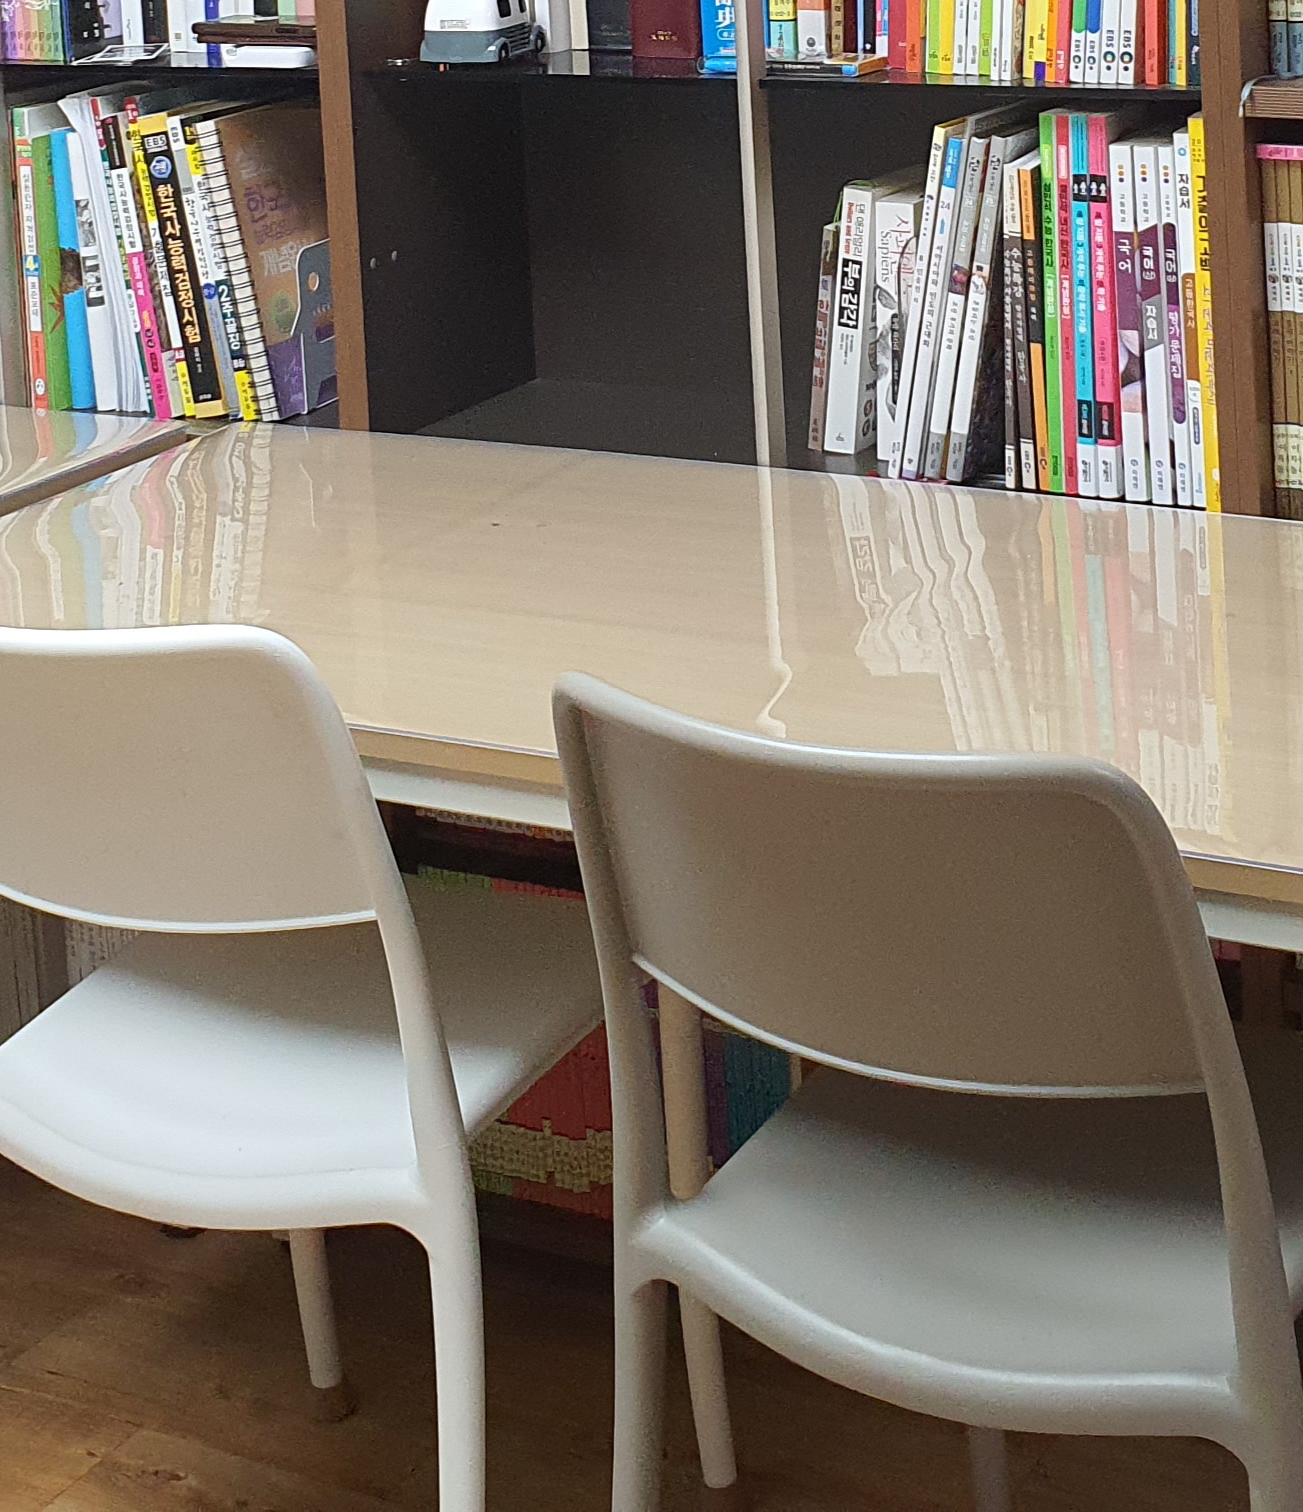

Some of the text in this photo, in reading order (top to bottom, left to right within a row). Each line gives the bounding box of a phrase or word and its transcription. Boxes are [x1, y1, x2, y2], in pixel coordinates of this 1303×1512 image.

[1124, 30, 1132, 48] EBS
[145, 135, 166, 149] EBS
[940, 201, 951, 210] 24
[1178, 173, 1191, 209] 자습서
[853, 203, 865, 258] 댄 애리얼리
[156, 183, 202, 344] 한국사 능력검정시험
[881, 231, 892, 283] Sapiens
[1118, 239, 1132, 273] 국어
[840, 261, 862, 328] 부의 감각
[1145, 305, 1158, 341] 자습서
[1169, 311, 1182, 379] 평가 문제집
